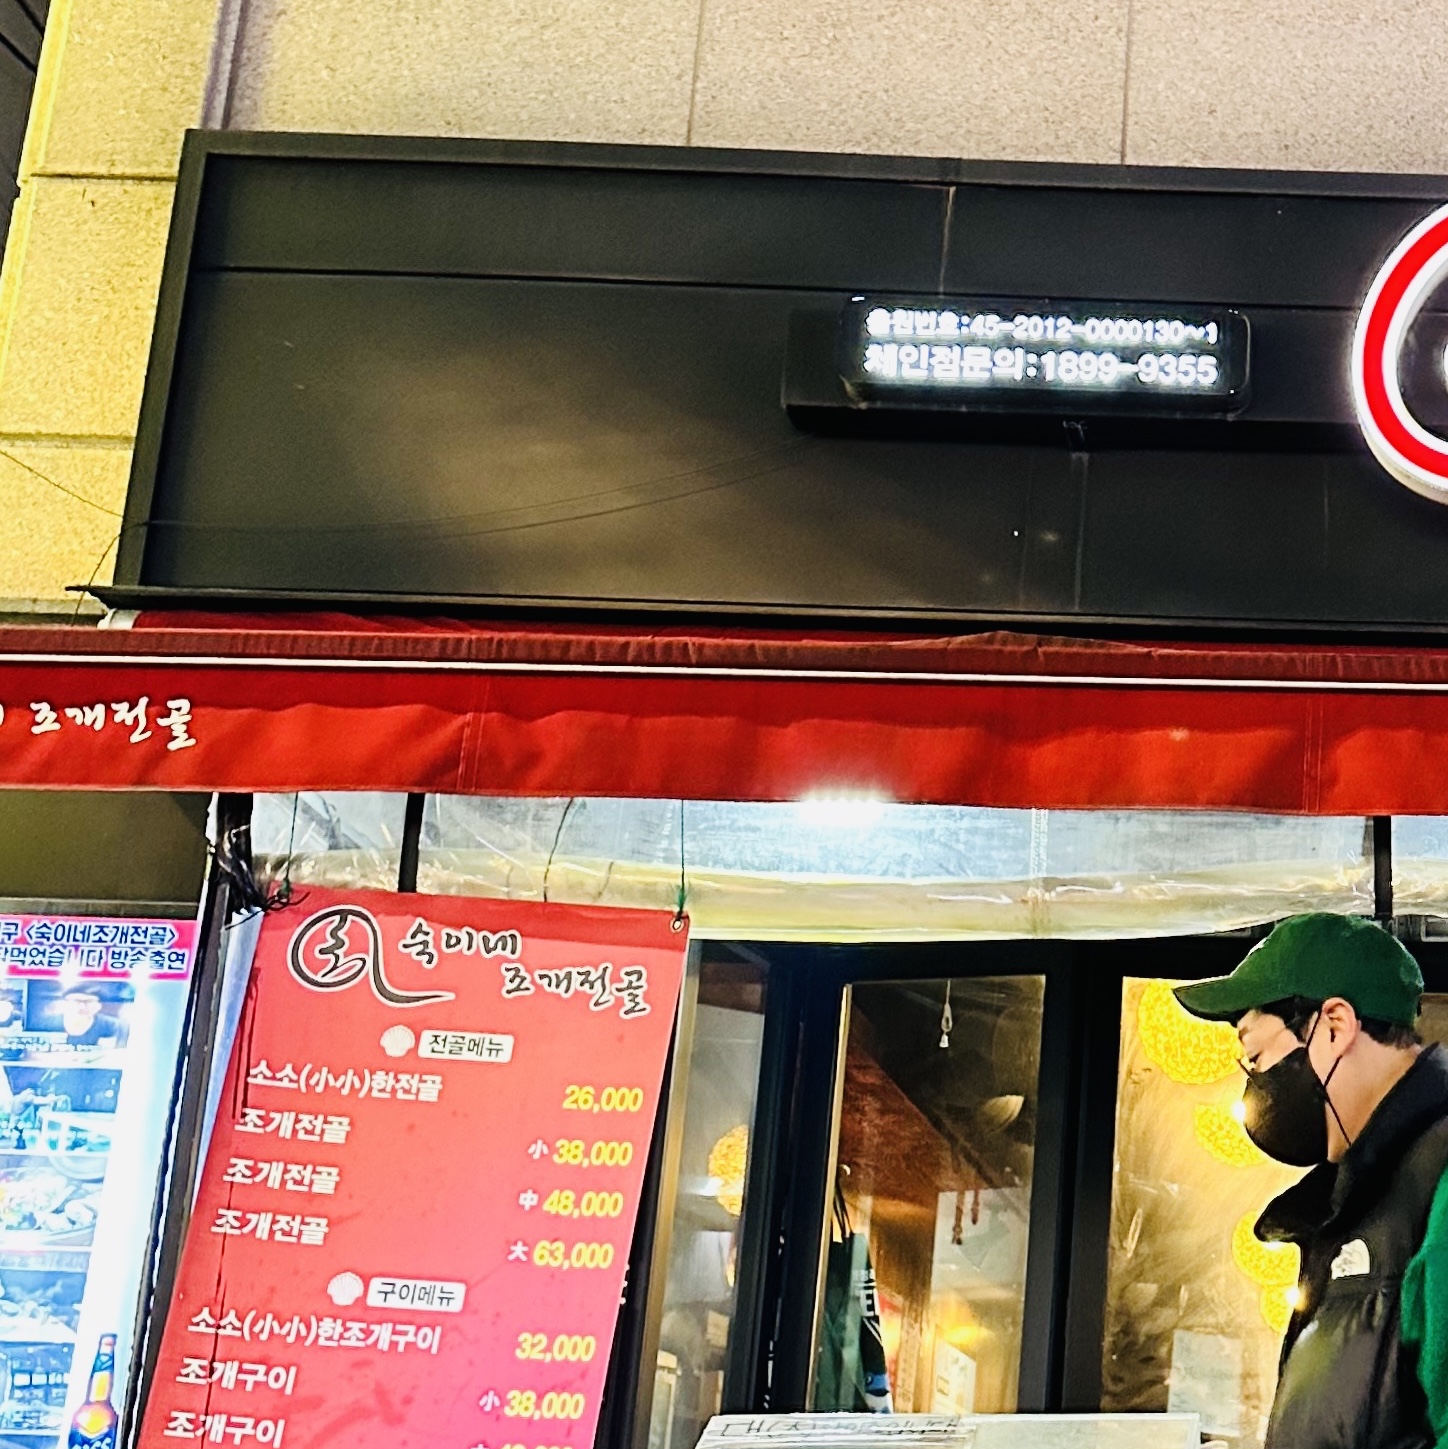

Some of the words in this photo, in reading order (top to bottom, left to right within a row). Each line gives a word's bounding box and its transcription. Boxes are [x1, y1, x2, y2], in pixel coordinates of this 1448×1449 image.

[30, 696, 197, 751] 조개전골
[0, 922, 19, 941] 구
[402, 921, 519, 966] 숙이네
[504, 965, 650, 1016] 조개전골
[428, 1034, 505, 1058] 전골메뉴
[247, 1060, 443, 1102] 소소(小小)한전골
[563, 1085, 643, 1114] 26,000
[234, 1107, 351, 1144] 조개전골
[528, 1139, 549, 1159] 小
[552, 1139, 633, 1168] 38,000
[223, 1158, 340, 1195] 조개전골
[519, 1189, 539, 1210] 中
[542, 1189, 623, 1218] 48,000
[211, 1208, 329, 1245] 조개전골
[507, 1241, 528, 1261] 大
[533, 1240, 614, 1270] 63,000
[376, 1282, 456, 1307] 구이메뉴
[515, 1332, 596, 1362] 32,000
[176, 1357, 297, 1395] 조개구이
[479, 1391, 500, 1412] 小
[503, 1390, 585, 1420] 38,000
[163, 1411, 285, 1448] 조개구이
